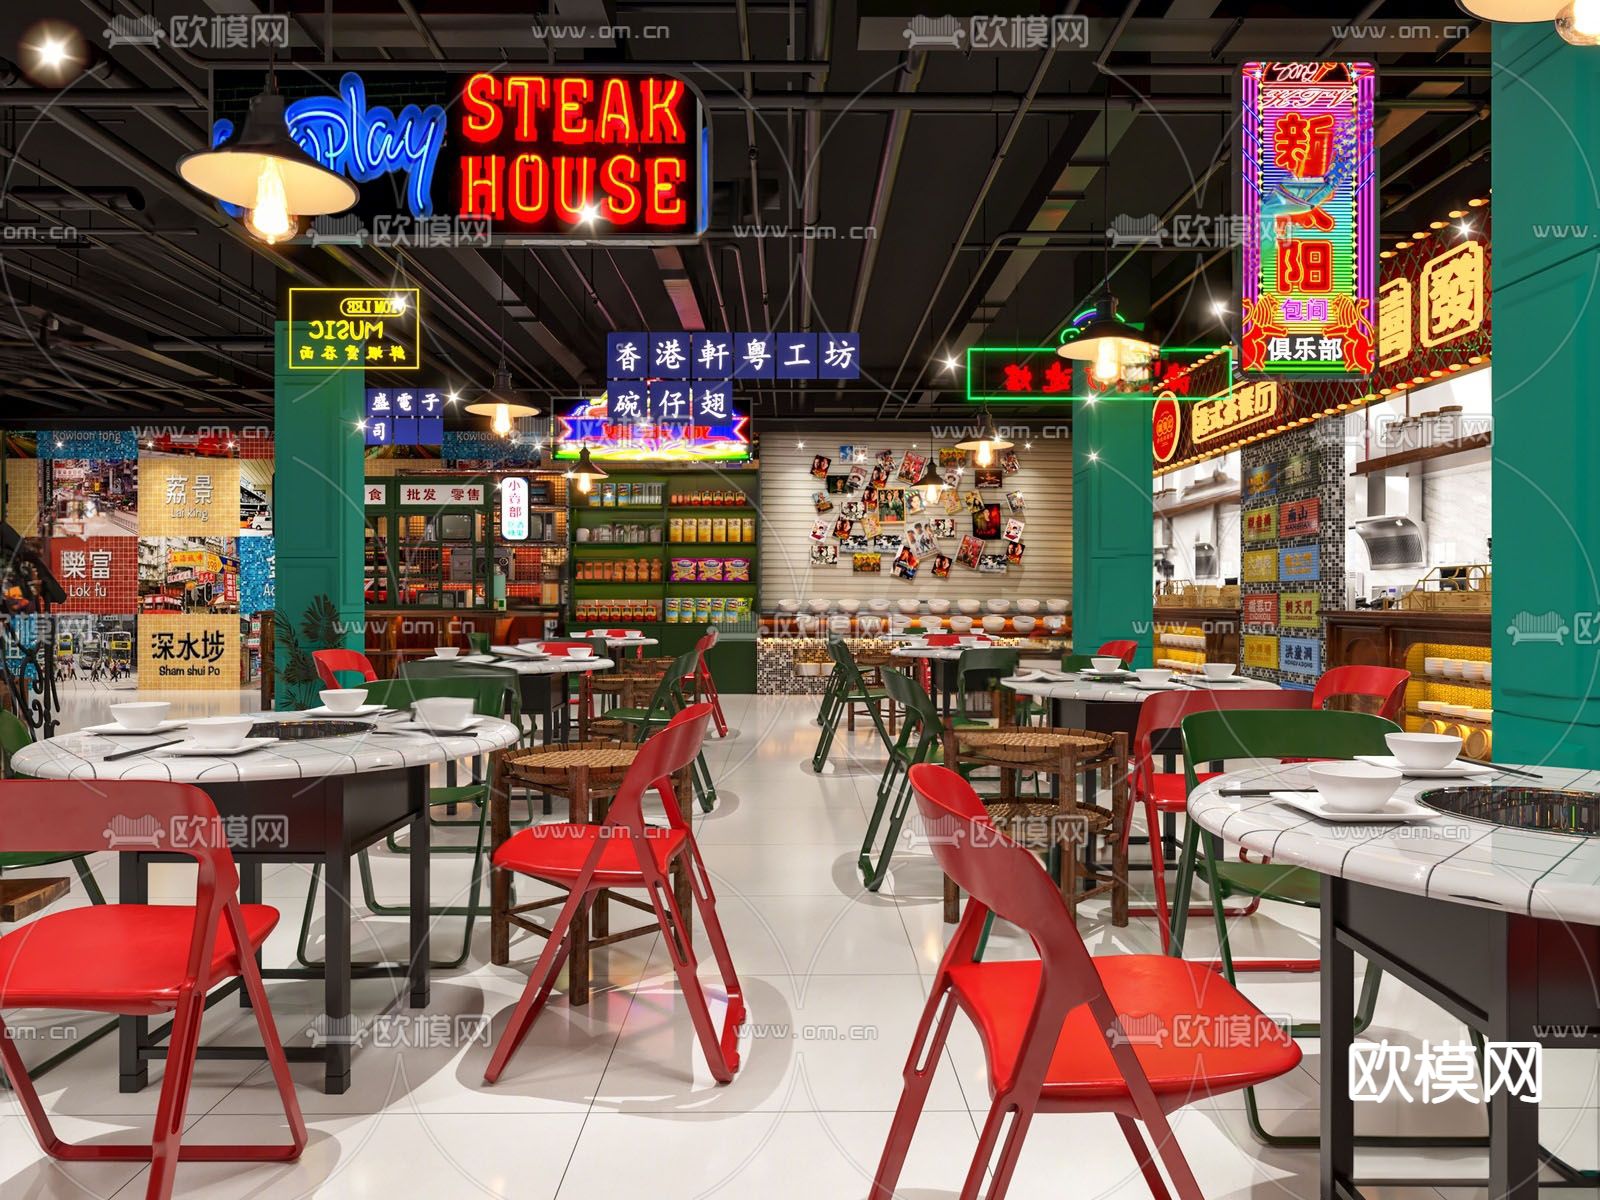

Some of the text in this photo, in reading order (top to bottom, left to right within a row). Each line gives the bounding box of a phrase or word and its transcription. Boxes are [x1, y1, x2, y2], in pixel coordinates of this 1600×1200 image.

[461, 71, 686, 144] STEAK
[460, 153, 687, 224] HOUSE
[1281, 297, 1329, 323] 包间
[1268, 336, 1344, 362] 俱乐部
[371, 392, 440, 412] 盛電子
[614, 389, 726, 418] 碗仔翅
[373, 423, 386, 440] 司
[166, 474, 214, 505] 荔景
[368, 488, 382, 501] 食
[406, 488, 480, 501] 批发 零售
[171, 507, 208, 522] Lai king
[60, 548, 112, 580] 樂富
[69, 583, 107, 597] Lok fu
[151, 630, 226, 663] 深水埗
[158, 665, 221, 676] Sham shui Po
